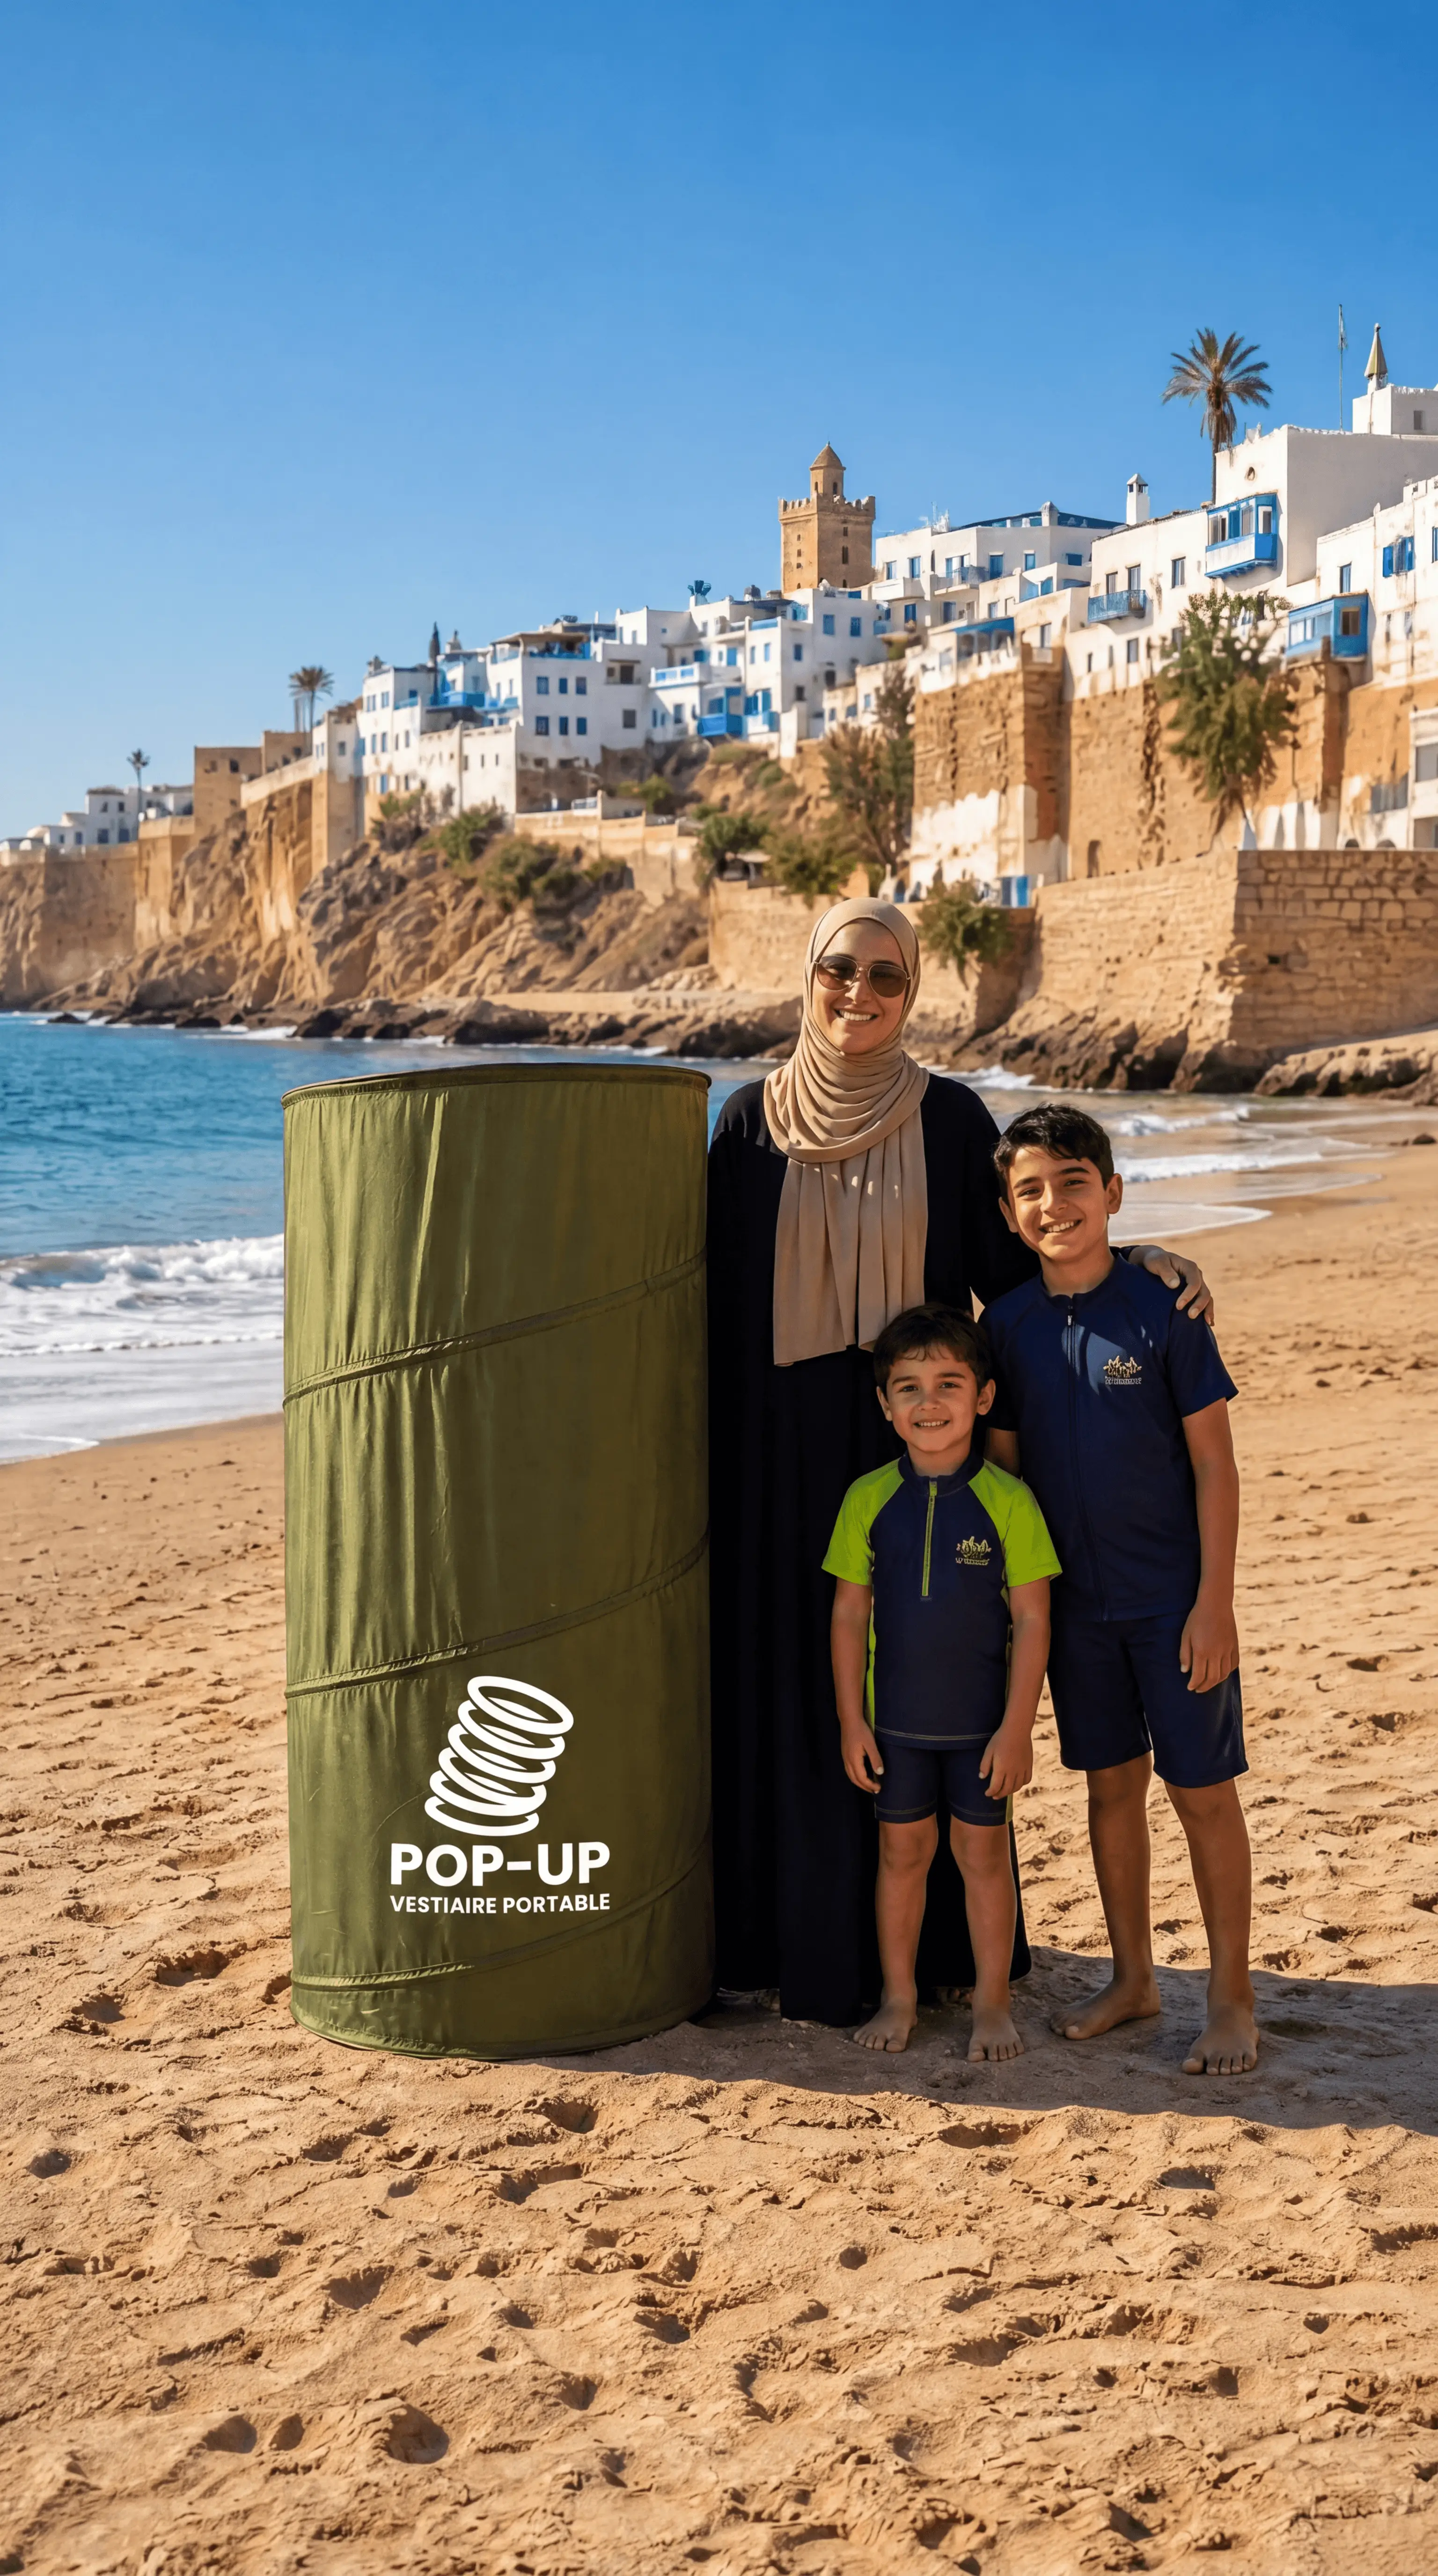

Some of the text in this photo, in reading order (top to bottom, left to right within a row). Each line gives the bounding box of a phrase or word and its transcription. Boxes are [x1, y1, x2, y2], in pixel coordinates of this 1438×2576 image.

[391, 1842, 610, 1887] POP-UP
[390, 1893, 610, 1914] VESTIAIRE PORTABLE
